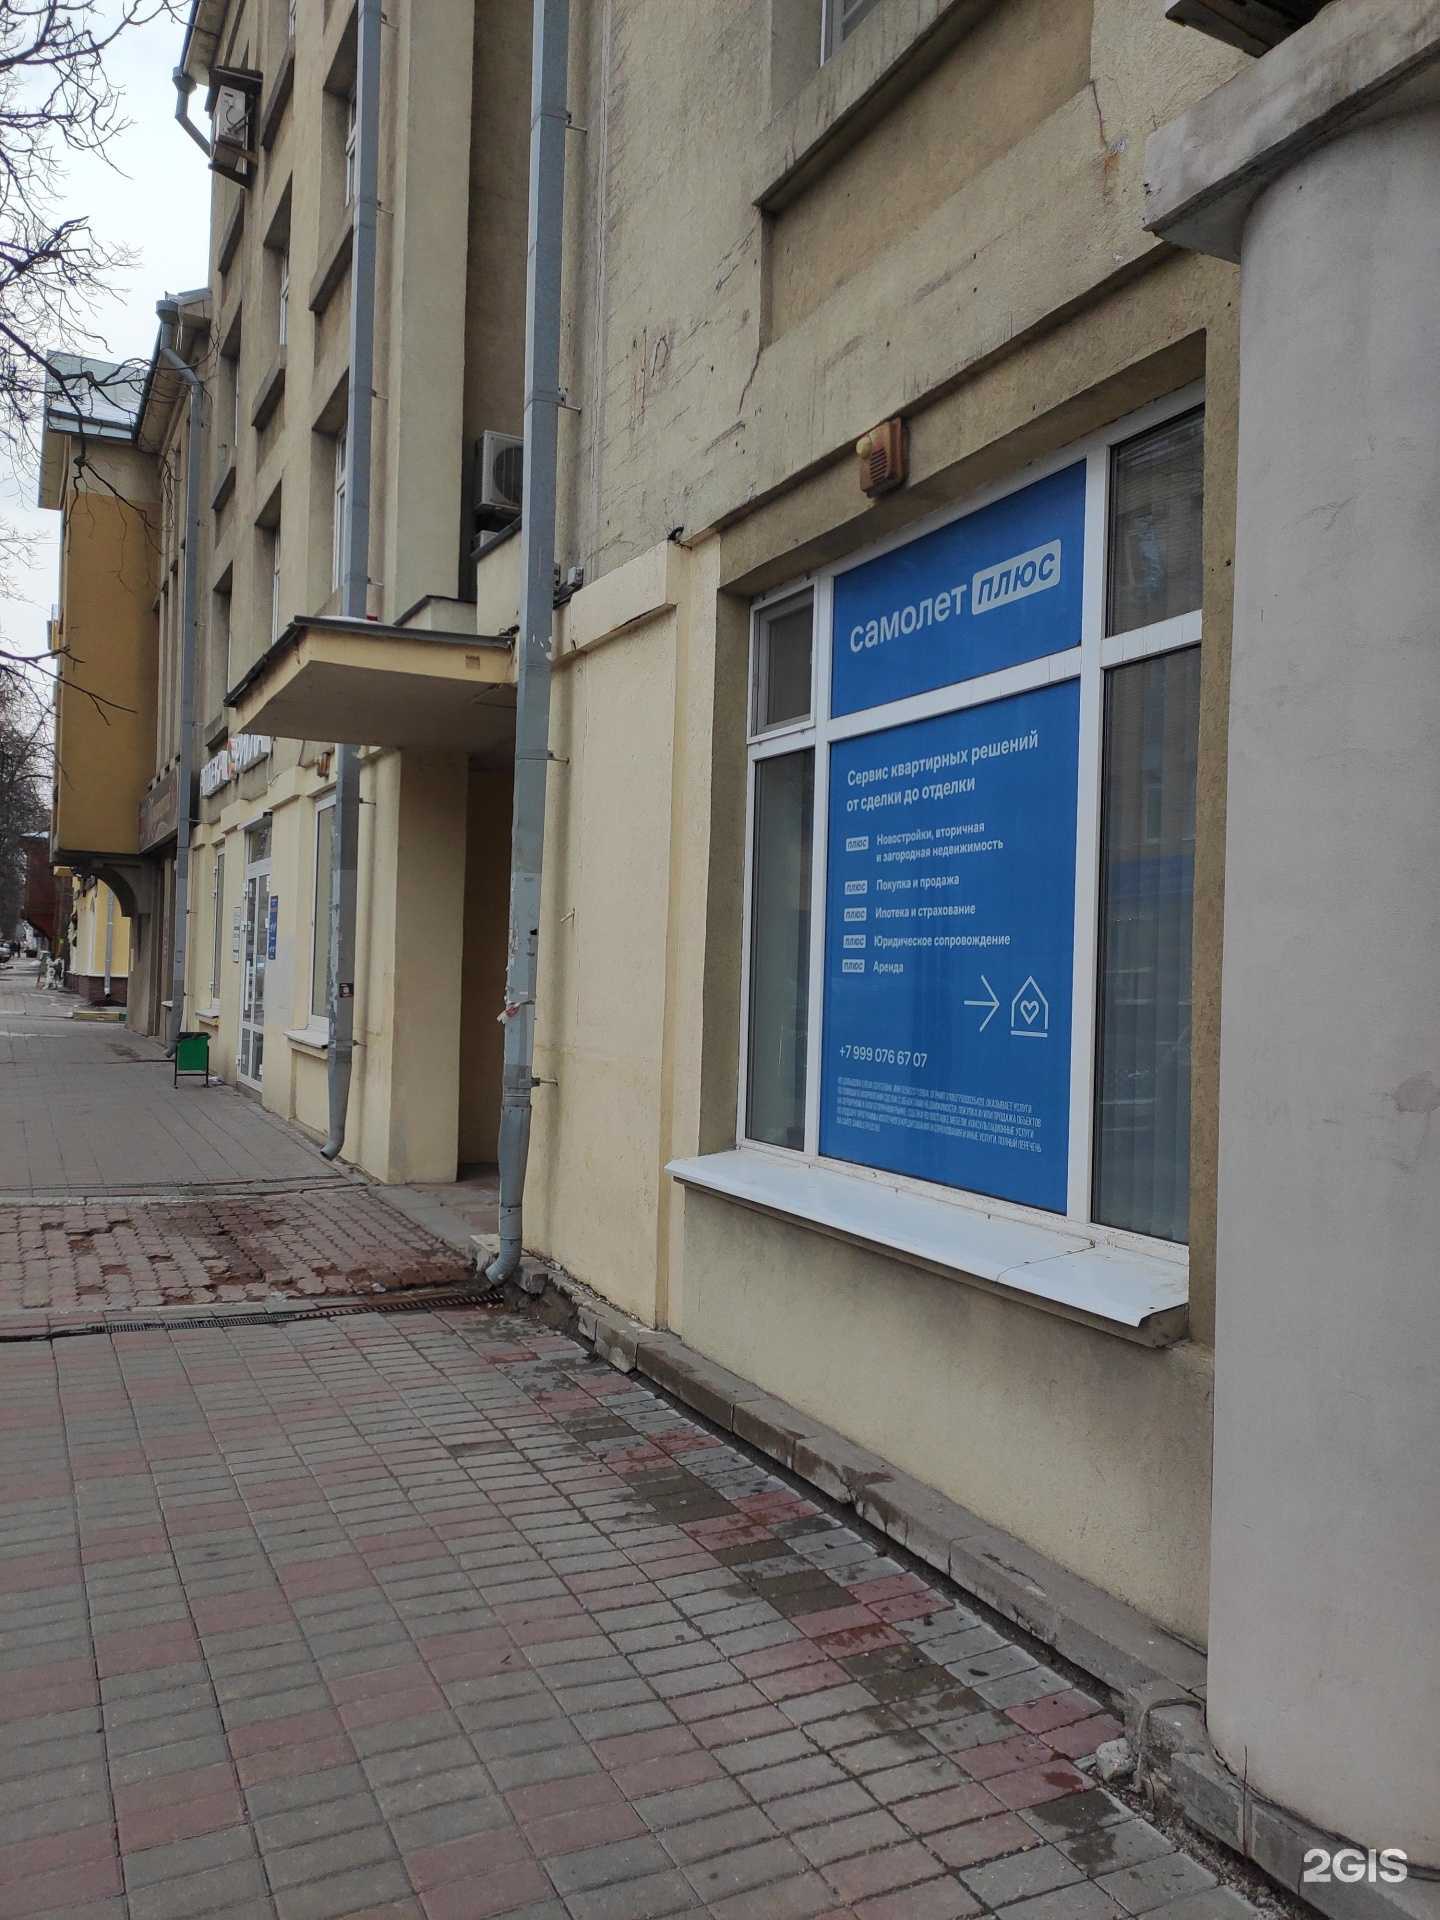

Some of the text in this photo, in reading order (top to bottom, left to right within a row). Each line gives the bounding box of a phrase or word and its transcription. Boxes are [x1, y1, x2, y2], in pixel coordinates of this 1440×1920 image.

[850, 584, 967, 653] самолет
[847, 730, 1039, 788] Сервис квартирных решений
[846, 777, 976, 812] от сделки до отделки
[876, 829, 934, 846] Новостройки,
[935, 822, 985, 839] вторичная
[876, 839, 1004, 864] и загородная недвижимость
[876, 878, 912, 892] Покупка
[912, 878, 919, 887] и
[920, 874, 960, 891] продажа
[875, 907, 909, 919] Ипотека
[910, 907, 917, 917] и
[918, 904, 976, 919] страхование
[874, 935, 933, 948] Юридическое
[934, 934, 1011, 949] сопровождение
[873, 960, 903, 974] Аренда
[839, 1044, 928, 1068] +7 999 076 67 07
